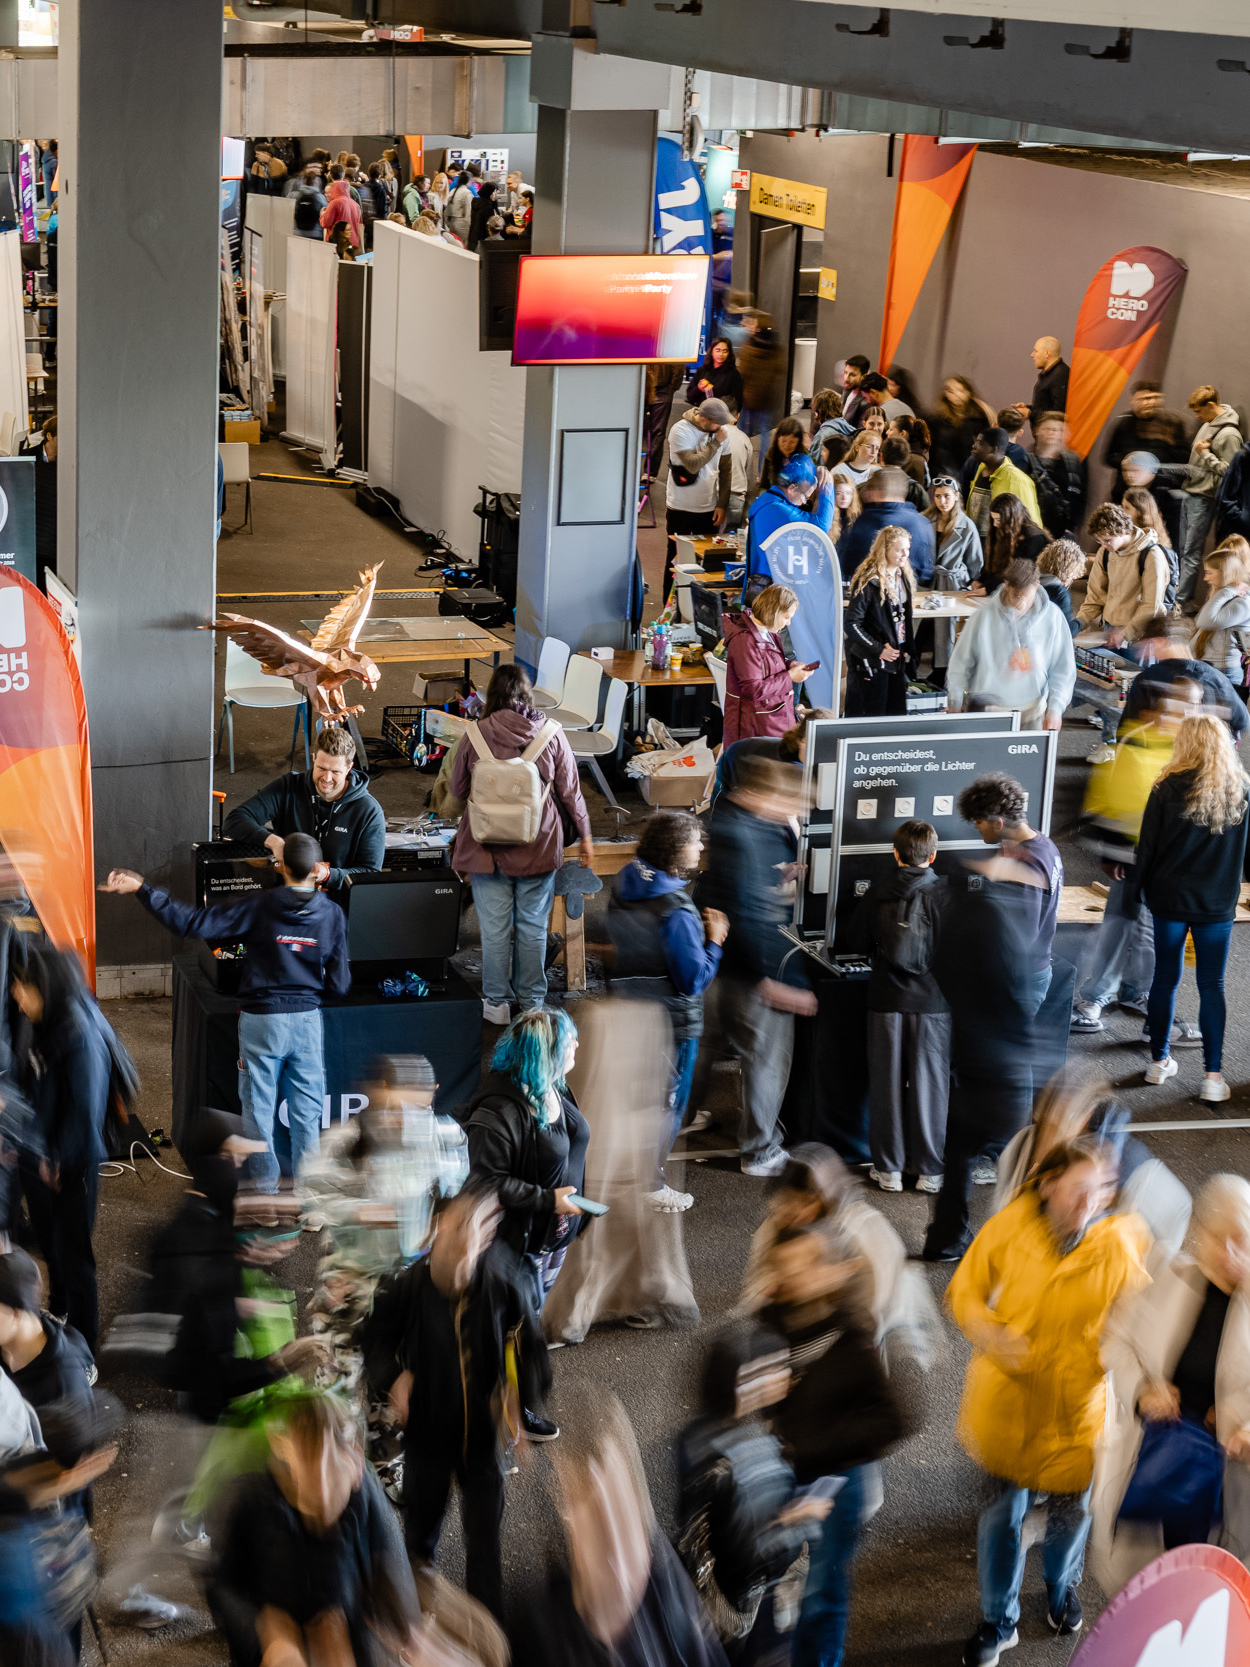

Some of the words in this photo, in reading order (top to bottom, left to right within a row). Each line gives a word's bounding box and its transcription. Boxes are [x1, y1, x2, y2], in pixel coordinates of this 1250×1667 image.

[1108, 297, 1148, 311] HERO
[1107, 308, 1137, 322] CON
[1008, 744, 1039, 754] GIRA
[855, 751, 869, 761] Du
[871, 750, 936, 761] entscheidest,
[854, 765, 867, 775] ob
[869, 763, 922, 776] gegenüber
[924, 762, 940, 772] die
[942, 761, 976, 771] Lichter
[853, 777, 899, 789] angehen.
[244, 883, 263, 891] gehört.
